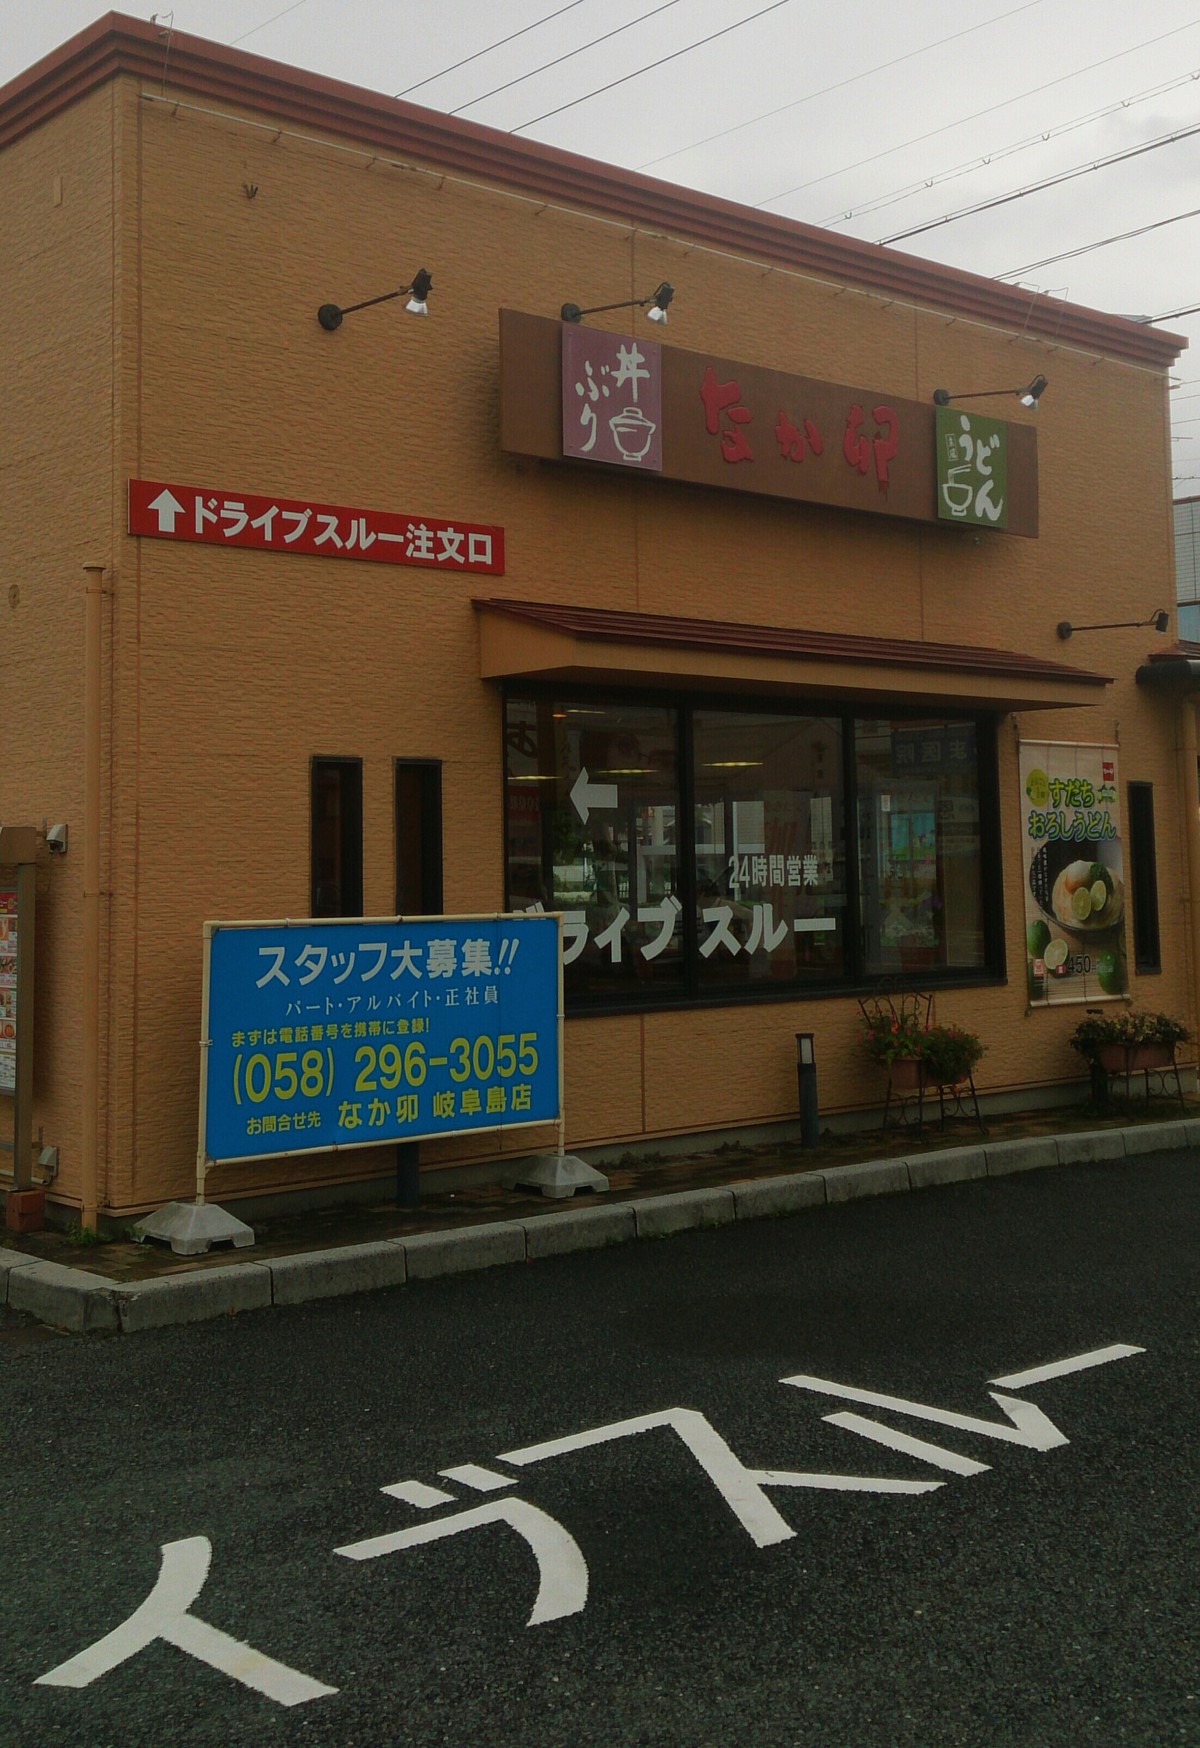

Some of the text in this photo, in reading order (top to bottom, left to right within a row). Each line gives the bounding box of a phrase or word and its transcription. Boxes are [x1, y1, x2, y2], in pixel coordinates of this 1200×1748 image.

[610, 342, 651, 403] 丼
[575, 360, 610, 452] ぶり
[700, 367, 899, 500] なか卯
[959, 414, 1004, 521] うどん
[194, 495, 493, 565] ドライブスルー注文口
[1047, 777, 1095, 808] すだち
[1027, 809, 1118, 842] おろしうどん
[728, 855, 819, 889] 24時間営業
[255, 938, 520, 989] スタッフ大募集!!
[1067, 954, 1092, 974] 450
[285, 985, 499, 1017] パート・アルバイト・正社員
[231, 1017, 431, 1048] まずは電話番号を携帯に登録!
[233, 1032, 539, 1105] (058) 296-3055
[246, 1083, 532, 1136] お問合せ先 なか卯 岐阜島店
